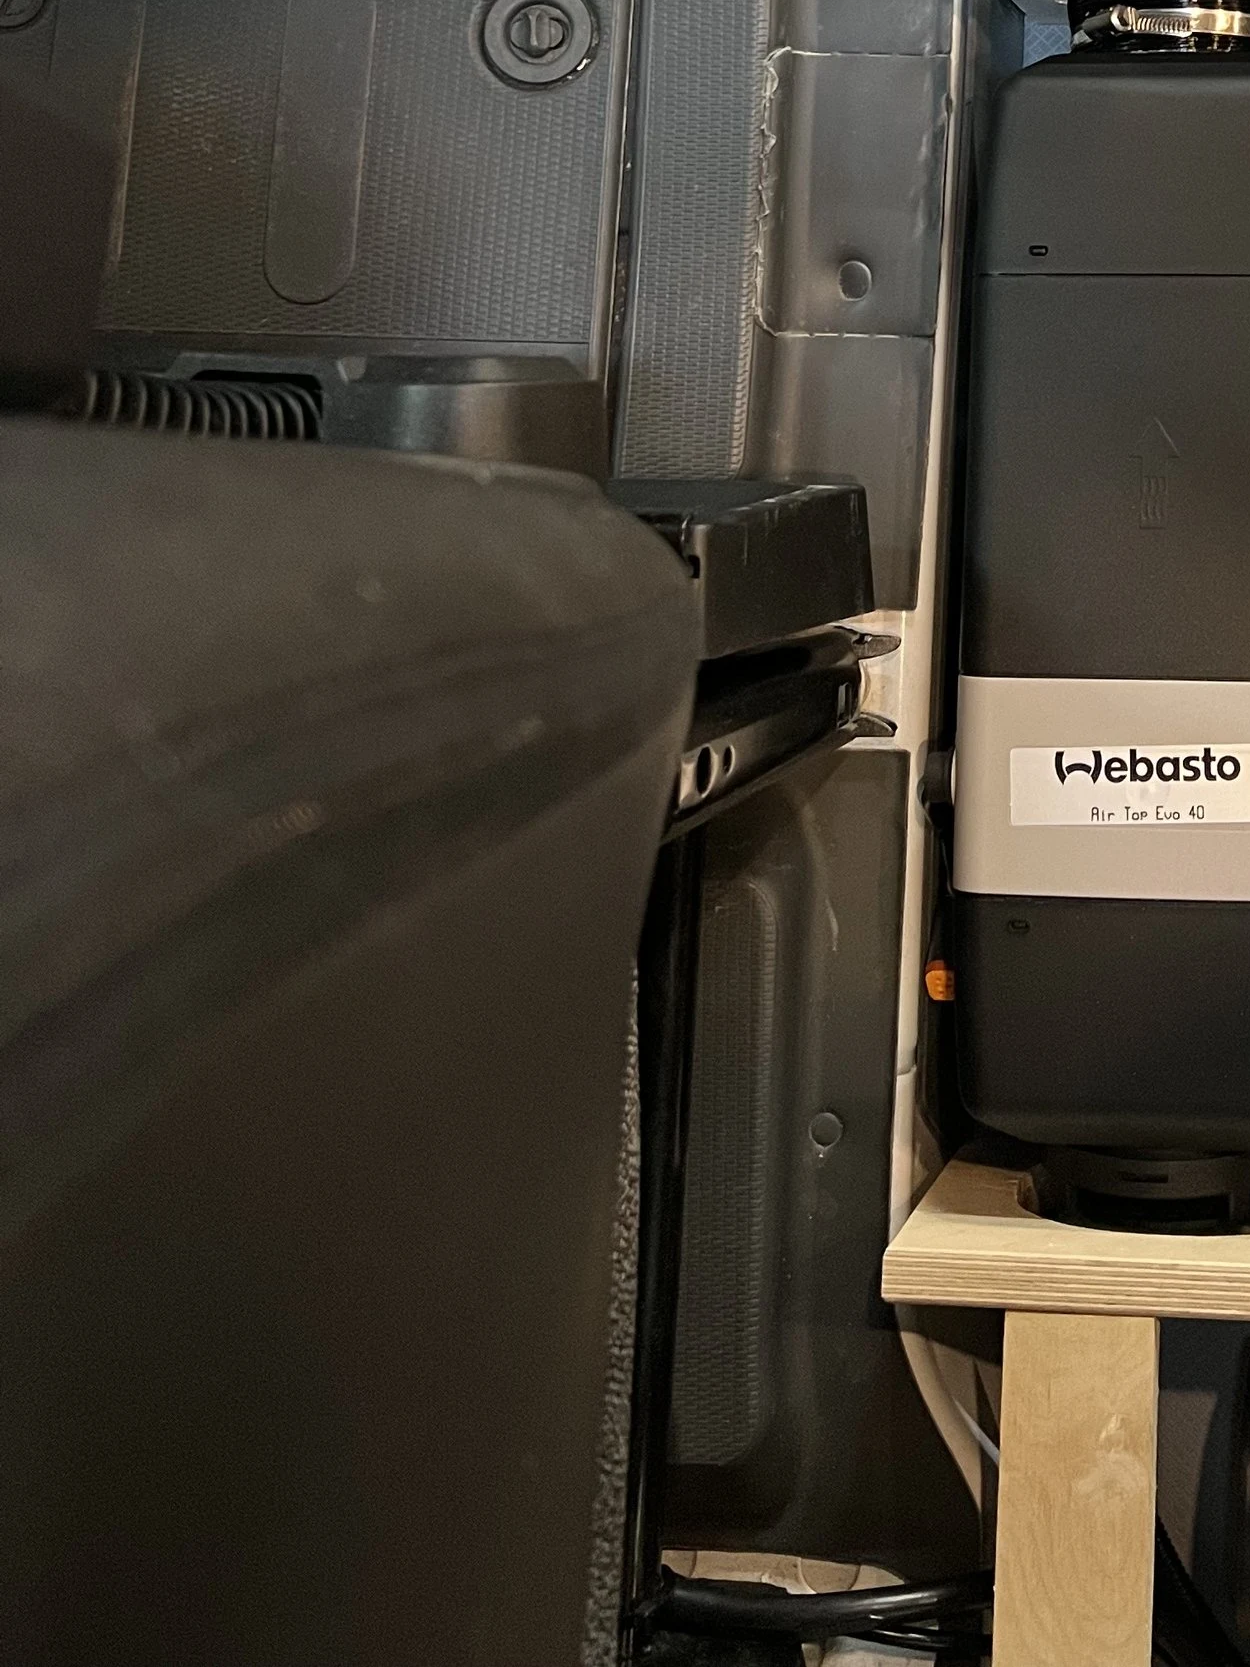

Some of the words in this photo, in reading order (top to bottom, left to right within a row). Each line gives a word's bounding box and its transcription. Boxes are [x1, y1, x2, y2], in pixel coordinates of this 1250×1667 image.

[1055, 747, 1241, 785] Webasto
[1091, 806, 1115, 822] Air
[1124, 806, 1148, 821] Top
[1156, 805, 1180, 821] Evo
[1188, 805, 1205, 820] 40
